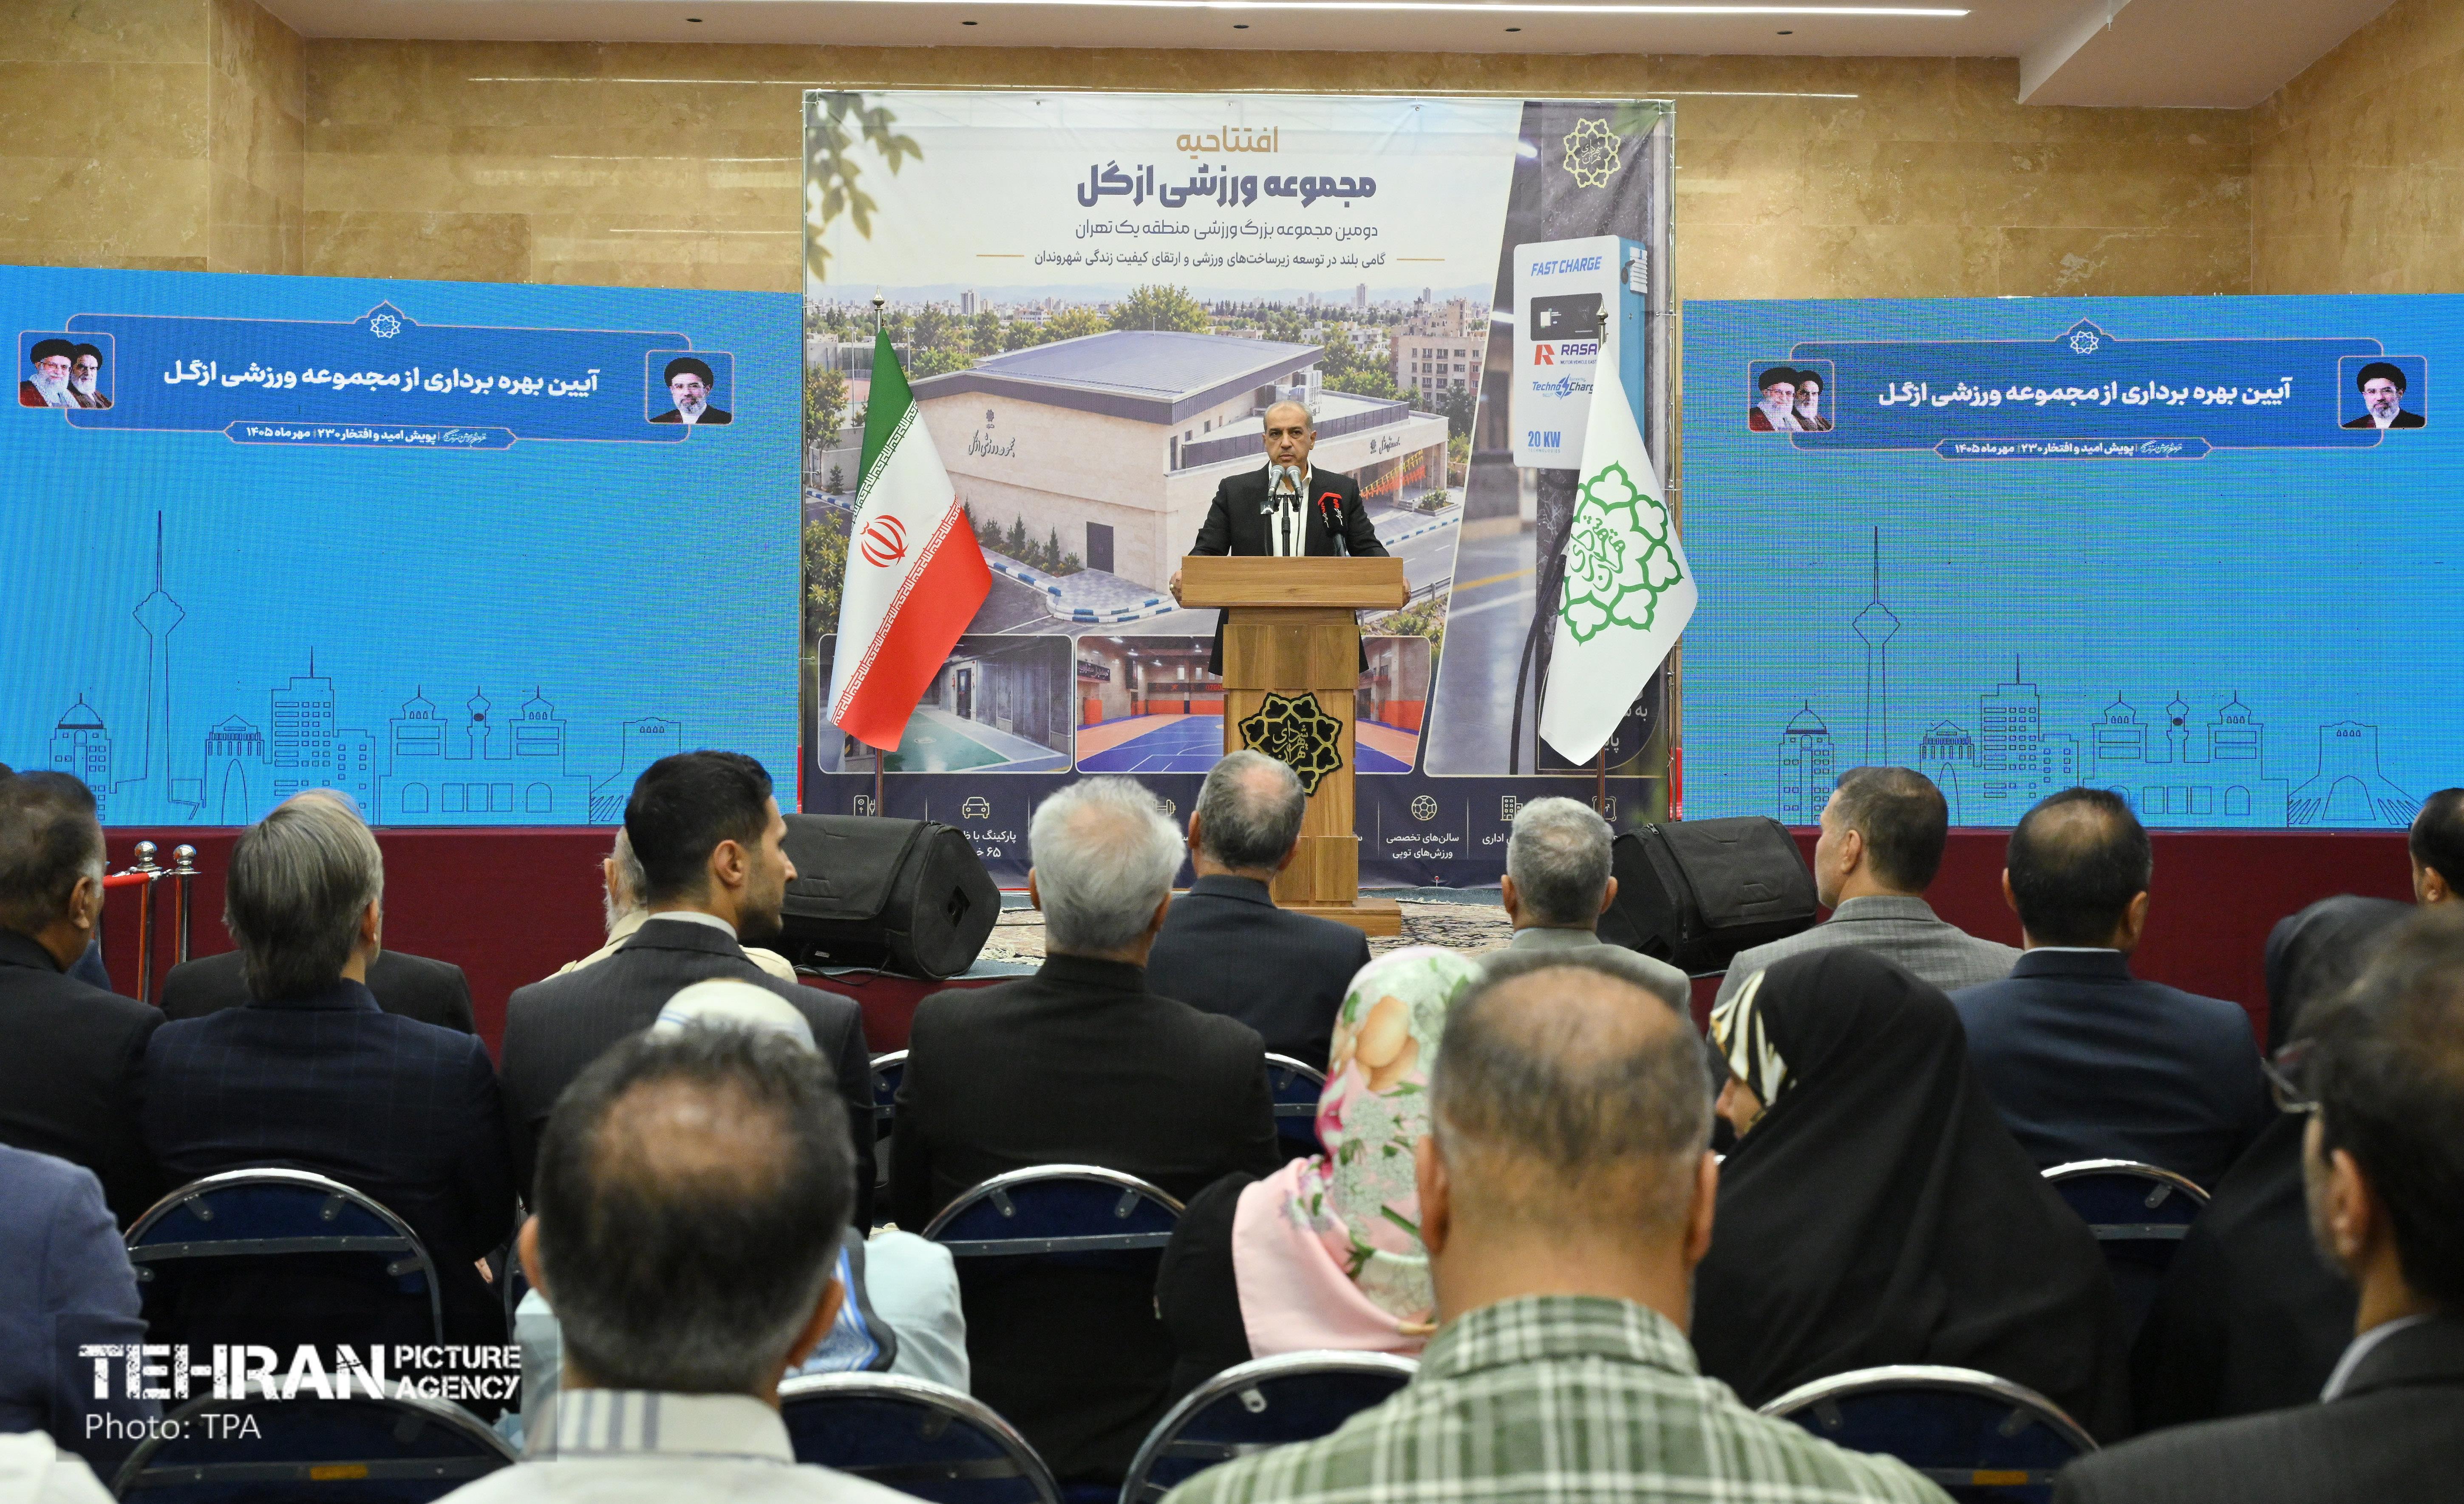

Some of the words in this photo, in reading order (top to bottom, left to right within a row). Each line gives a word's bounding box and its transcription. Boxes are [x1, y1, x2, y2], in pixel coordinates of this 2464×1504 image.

[1177, 125, 1278, 159] افتتاحیه
[1078, 160, 1153, 207] ازگل
[1160, 163, 1258, 208] ورزشی
[1263, 175, 1376, 208] مجموعه
[1076, 219, 1112, 239] تهران
[1116, 220, 1139, 237] یک
[1143, 220, 1190, 234] منطقه
[1195, 221, 1238, 240] ورزشی
[1240, 219, 1274, 239] بزرگ
[1277, 226, 1332, 240] مجموعه
[1336, 226, 1378, 241] دومین
[1035, 250, 1082, 266] شهروندان
[1085, 249, 1113, 266] زندگی
[1116, 251, 1148, 266] کیفیت
[1152, 251, 1180, 266] ارتقای
[1184, 256, 1189, 266] و
[1192, 254, 1223, 267] ورزشی
[1293, 254, 1324, 268] توسعه
[1326, 256, 1337, 268] در
[1340, 254, 1358, 268] بلند
[1362, 252, 1385, 268] گامی
[1531, 260, 1558, 277] FAST
[1559, 256, 1602, 274] CHARGE
[1561, 343, 1597, 355] RASA
[164, 359, 216, 385] ازگل
[221, 362, 297, 388] ورزشی
[302, 368, 400, 391] مجموعه
[401, 367, 419, 391] از
[424, 368, 493, 394] برداری
[548, 369, 600, 397] آیین
[1569, 382, 1594, 394] Charg
[1879, 382, 1926, 406] ازگل
[1932, 382, 2002, 406] ورزشی
[2006, 386, 2099, 406] مجموعه
[2100, 381, 2117, 405] از
[2122, 381, 2189, 405] برداری
[2242, 377, 2293, 404] آیین
[382, 430, 403, 442] امید
[405, 430, 436, 445] پویش
[1528, 431, 1541, 447] 20
[1544, 431, 1561, 447] KW
[2081, 443, 2102, 455] امید
[1635, 706, 1648, 721] به
[974, 831, 980, 842] با
[982, 830, 1017, 844] پارکینگ
[1386, 834, 1420, 844] تخصصی
[1482, 833, 1504, 845] اداری
[987, 847, 1001, 857] ۶۵
[1393, 849, 1411, 859] توپی
